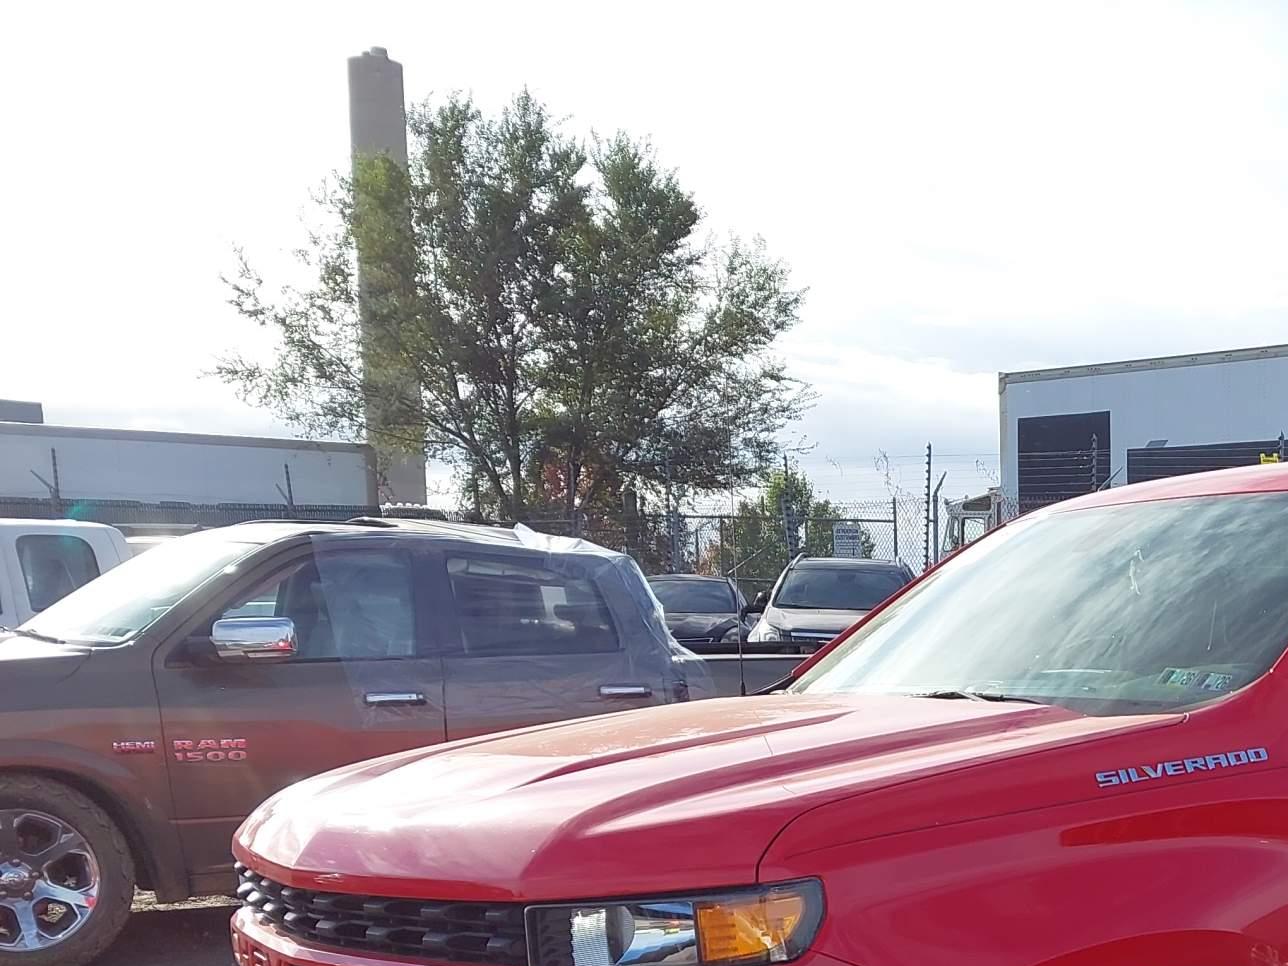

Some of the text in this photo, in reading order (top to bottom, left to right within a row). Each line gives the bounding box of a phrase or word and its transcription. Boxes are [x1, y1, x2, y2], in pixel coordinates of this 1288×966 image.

[112, 741, 155, 752] HEMI
[173, 739, 247, 750] RAM
[174, 751, 247, 762] 1500
[1095, 746, 1269, 788] SILVERADO
